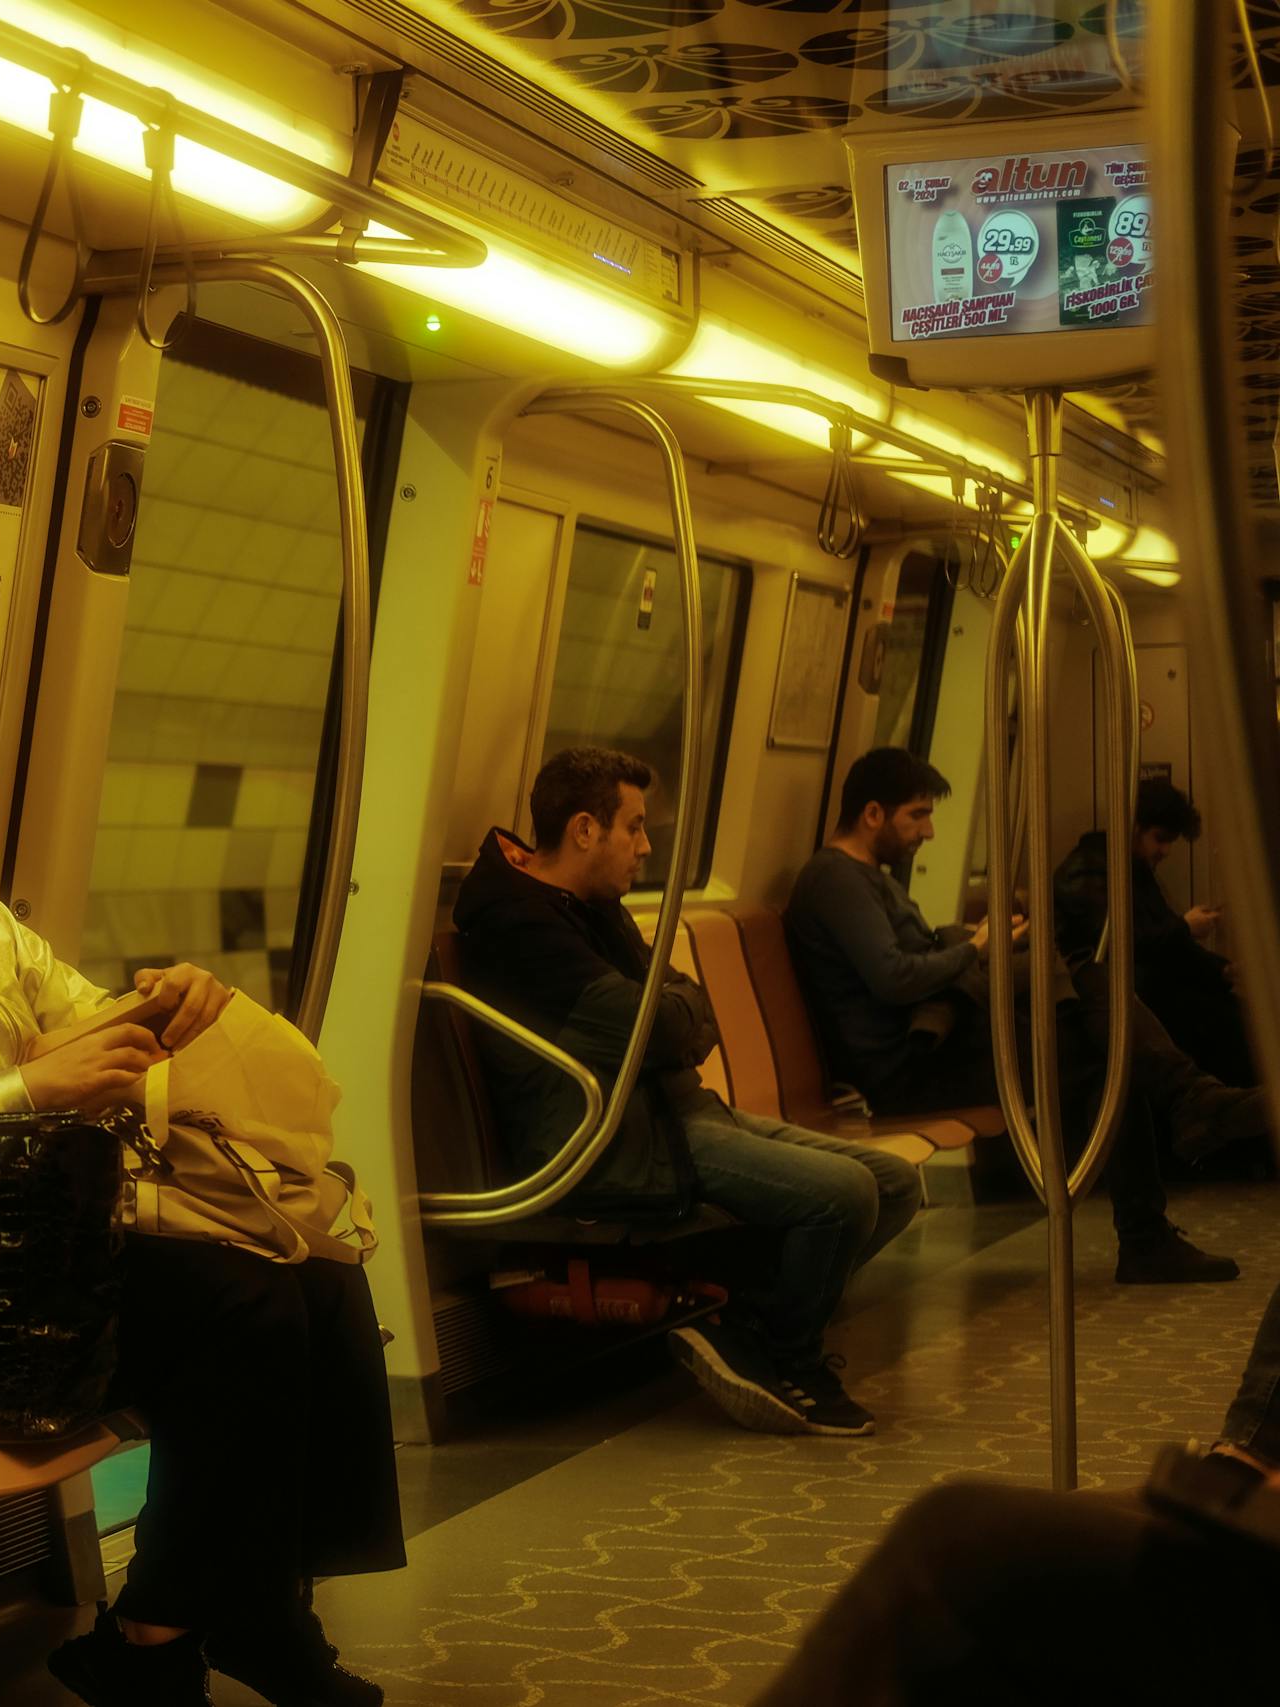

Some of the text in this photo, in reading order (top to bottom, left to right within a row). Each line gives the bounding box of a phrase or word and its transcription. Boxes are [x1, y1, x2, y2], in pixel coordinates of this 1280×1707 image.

[972, 158, 1087, 193] altun
[984, 229, 1033, 253] 29.99
[964, 311, 986, 326] 500
[1090, 299, 1117, 317] 1000
